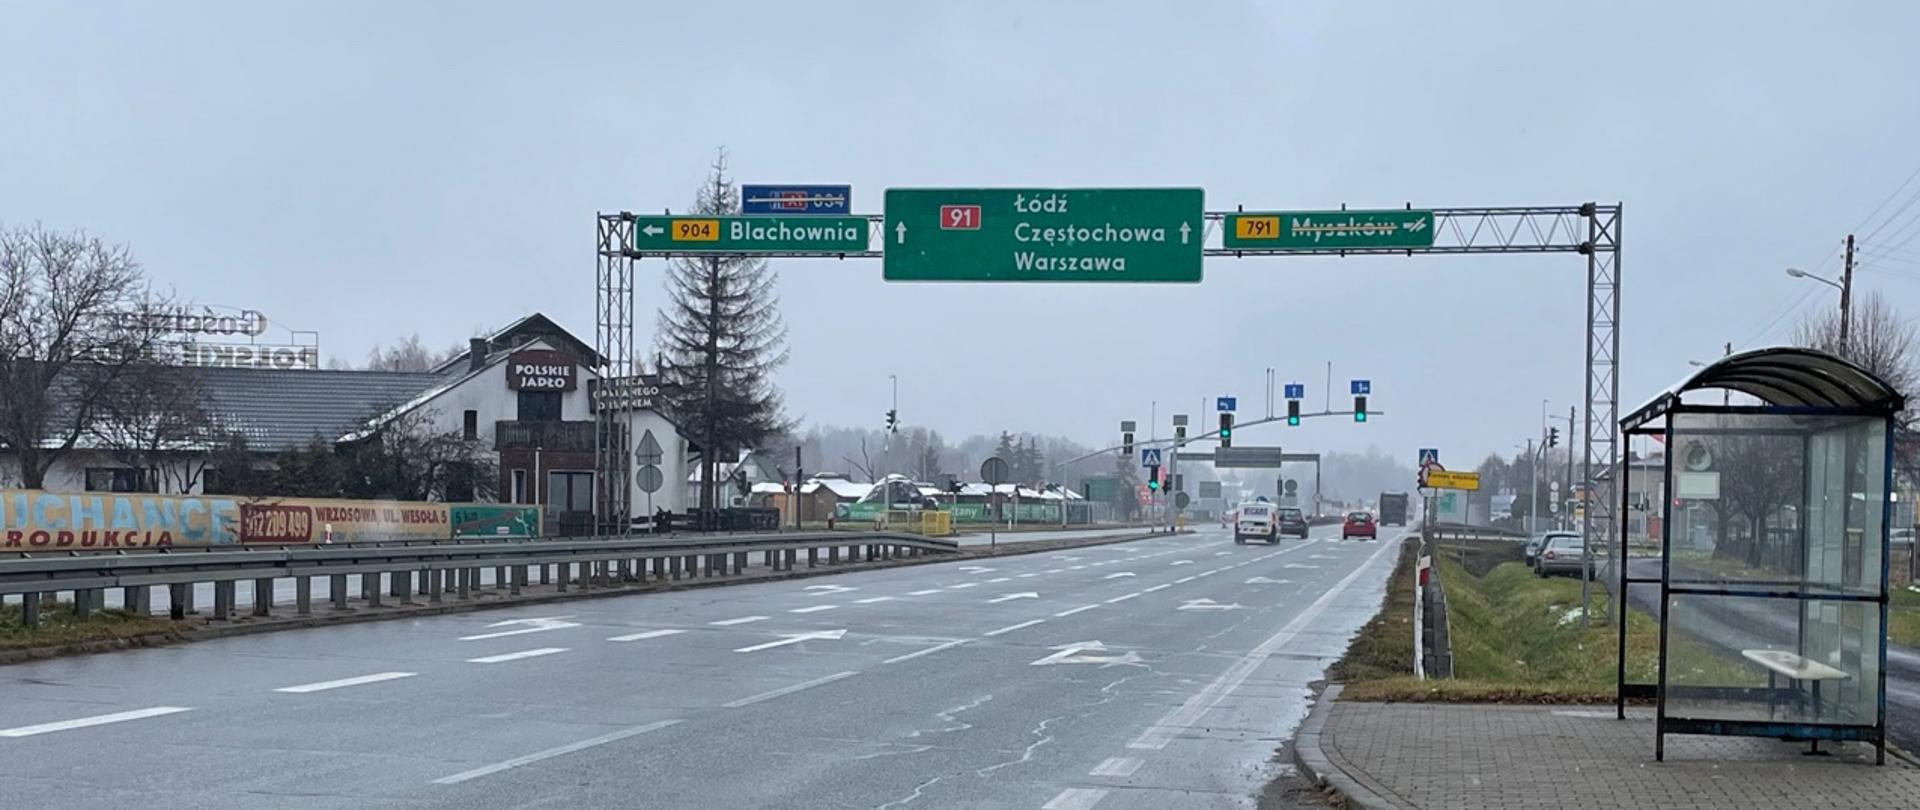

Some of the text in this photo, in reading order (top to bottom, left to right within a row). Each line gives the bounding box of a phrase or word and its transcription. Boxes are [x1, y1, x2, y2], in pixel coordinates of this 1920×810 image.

[1013, 193, 1068, 213] Łódź
[950, 208, 971, 227] 91
[680, 221, 858, 241] 904 Blachownia
[1014, 222, 1166, 247] Częstochowa
[1246, 215, 1397, 243] 791 Myszków
[1014, 251, 1126, 271] Warszawa
[515, 364, 570, 377] POLSKIE
[520, 377, 566, 388] JADŁO
[400, 509, 439, 524] WESOŁA
